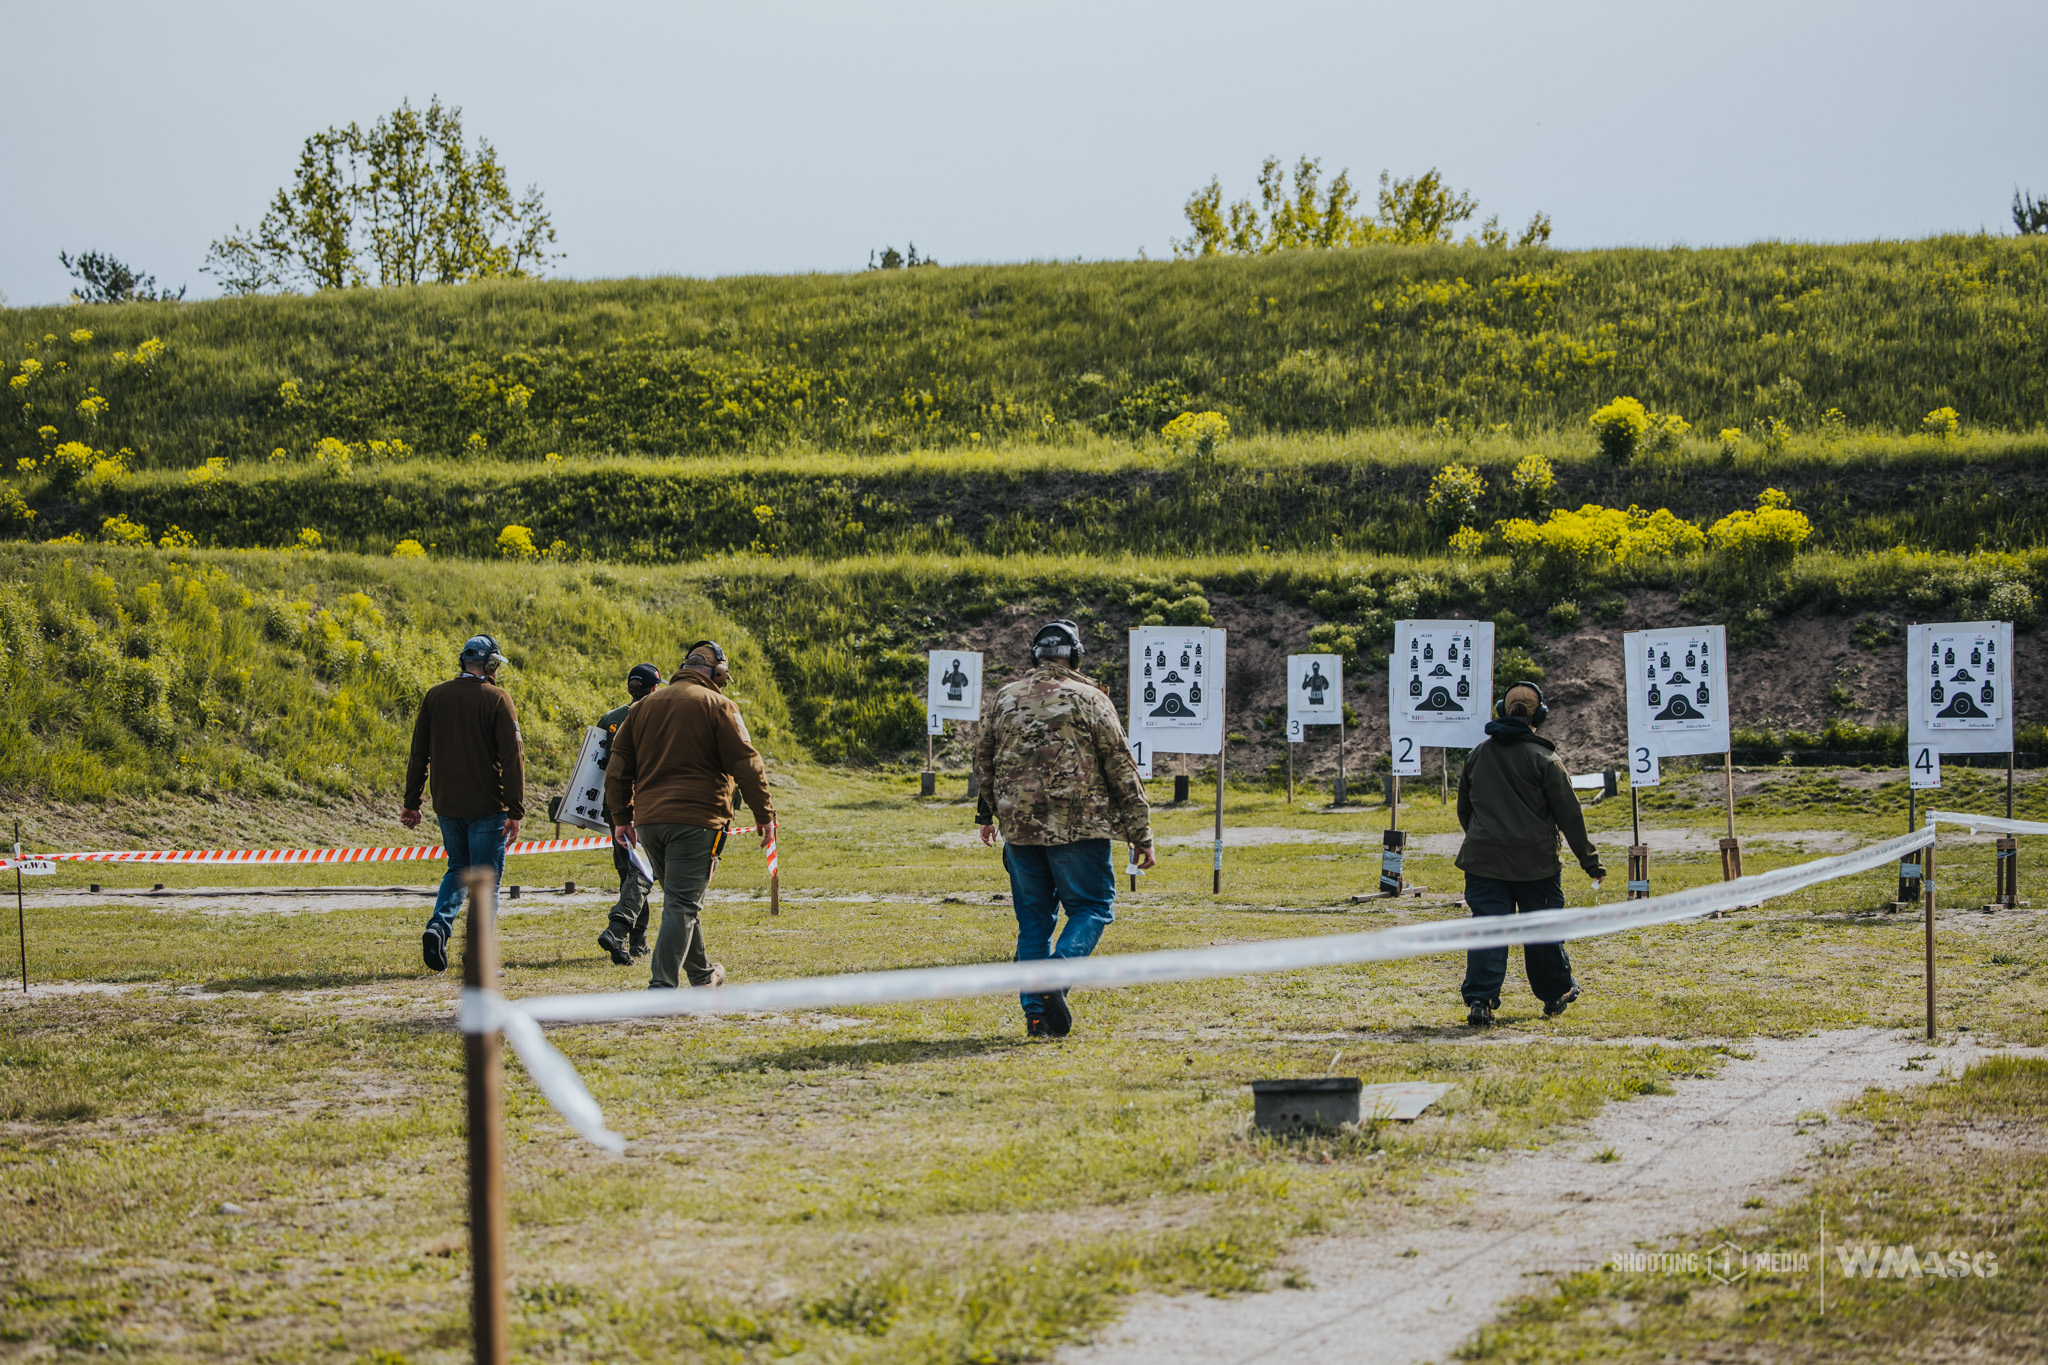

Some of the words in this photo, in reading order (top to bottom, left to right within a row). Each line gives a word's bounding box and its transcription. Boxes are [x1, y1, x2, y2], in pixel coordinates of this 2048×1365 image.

[932, 714, 939, 728] 1
[1291, 720, 1300, 735] 3
[1133, 742, 1145, 766] 1
[1399, 737, 1414, 763] 2
[1636, 747, 1651, 773] 3
[1915, 748, 1933, 774] 4
